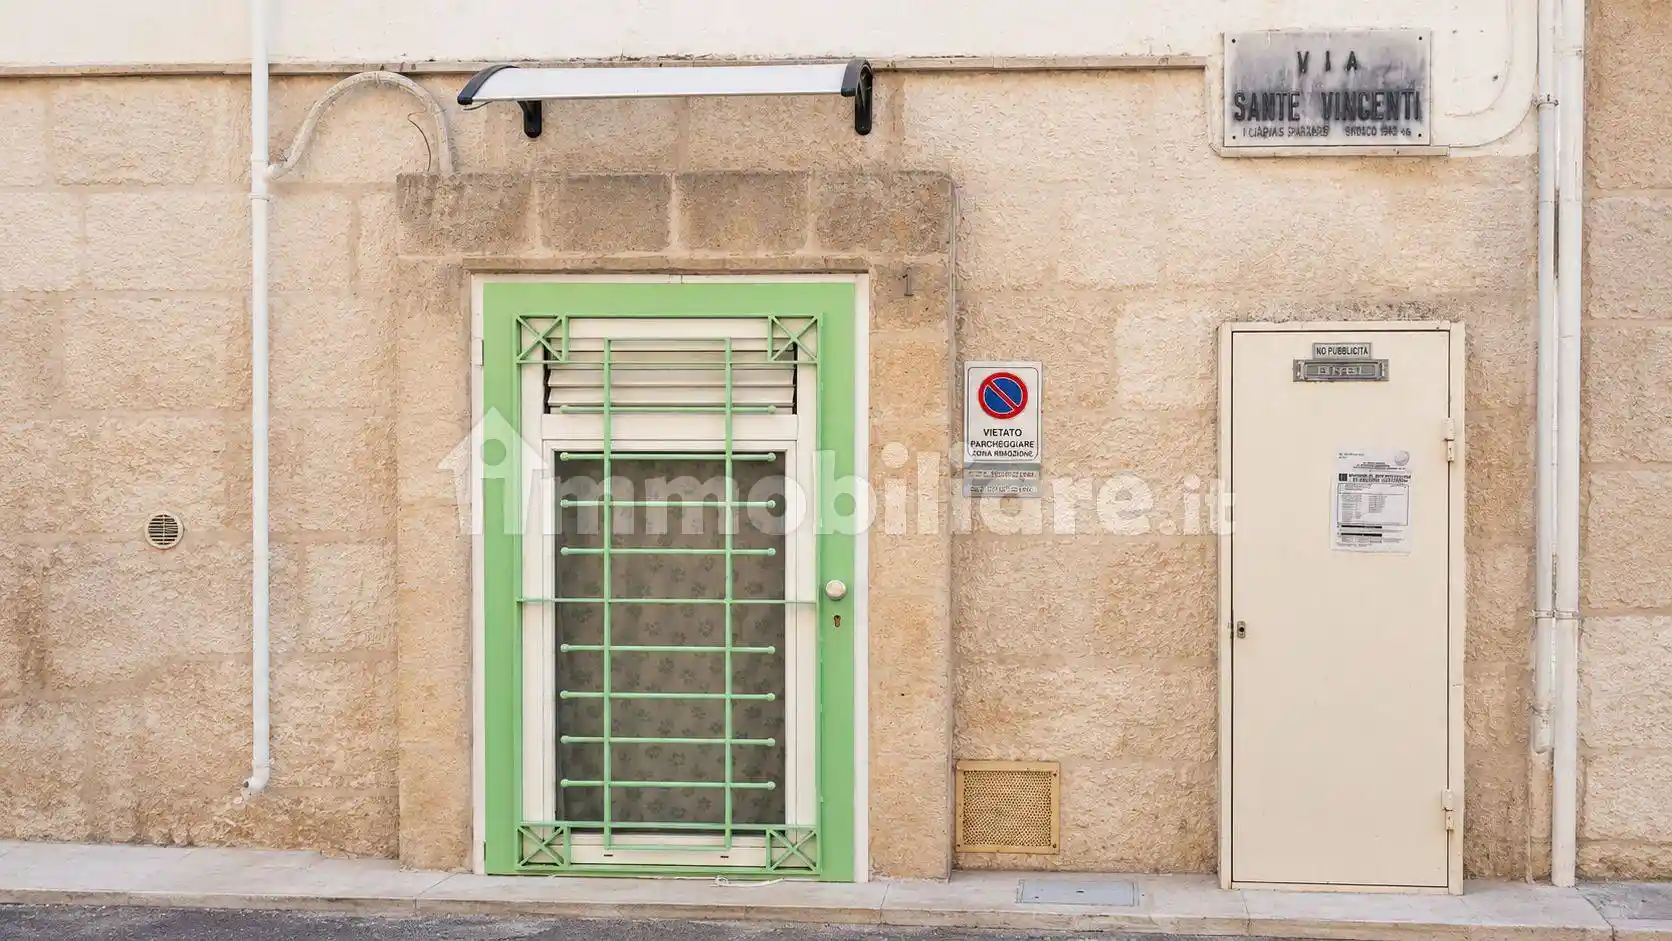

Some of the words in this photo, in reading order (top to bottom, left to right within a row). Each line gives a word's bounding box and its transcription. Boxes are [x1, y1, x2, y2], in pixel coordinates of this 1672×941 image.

[1297, 50, 1359, 74] VIA
[1233, 91, 1300, 122] SANTE
[1321, 90, 1422, 122] VINCENTI
[1316, 346, 1327, 356] NO
[983, 428, 1023, 437] VIETATO
[970, 440, 1035, 449] PARCHEGGIARE
[994, 450, 1034, 458] RIMOZIONE
